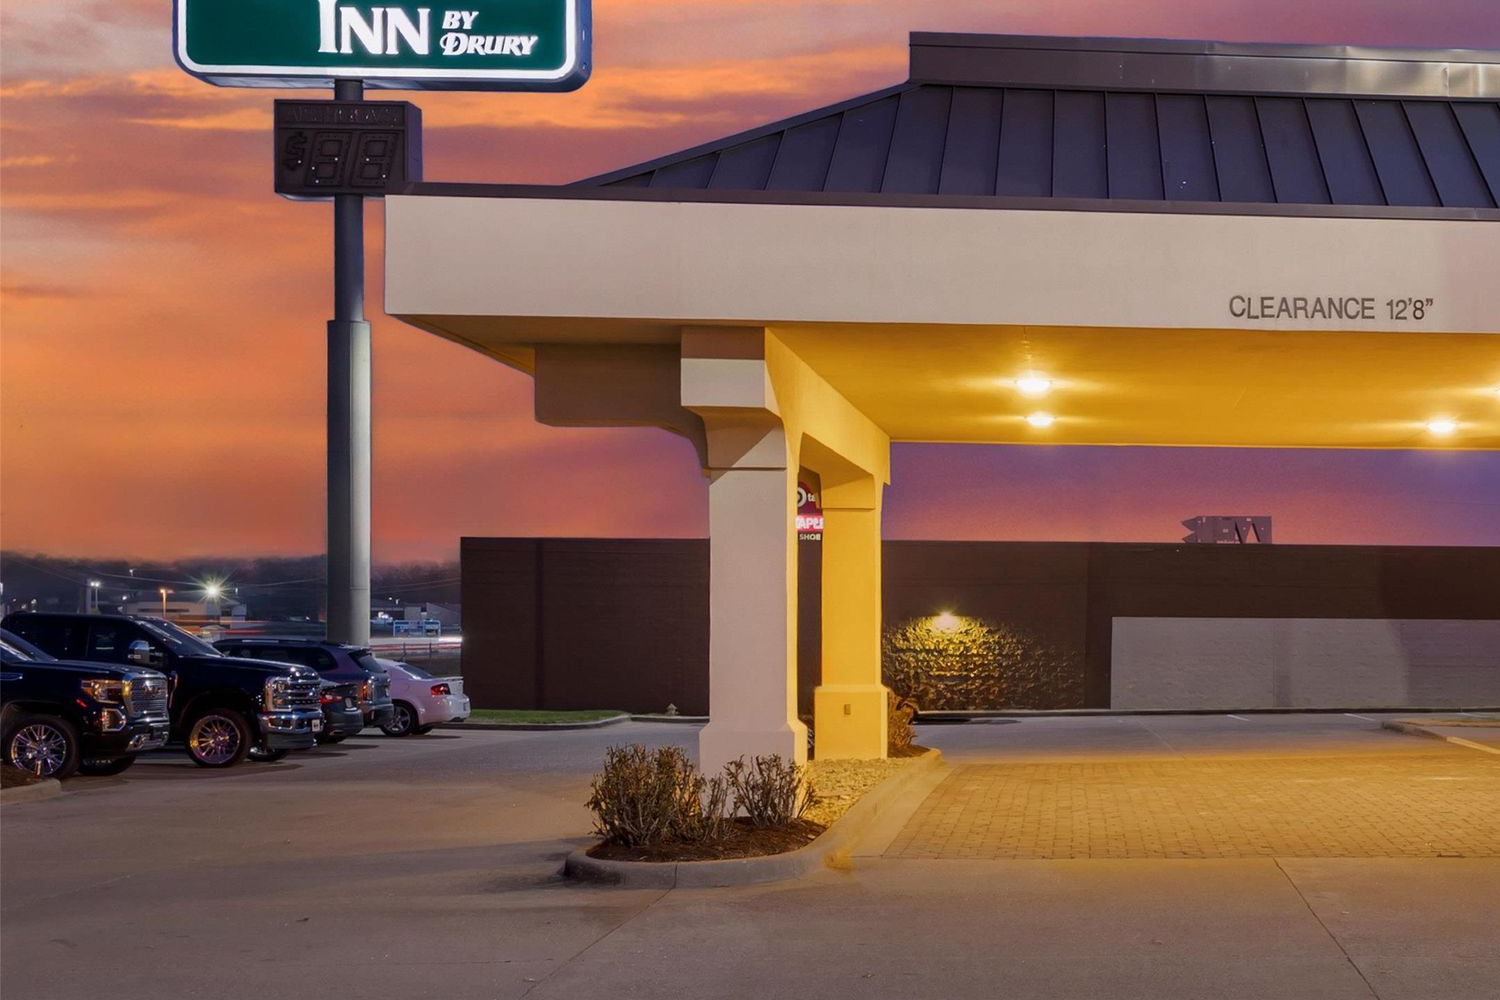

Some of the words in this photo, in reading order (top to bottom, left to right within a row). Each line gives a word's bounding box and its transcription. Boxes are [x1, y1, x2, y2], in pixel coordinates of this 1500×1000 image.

[442, 10, 480, 30] BY
[439, 32, 539, 57] DRURY
[1229, 295, 1376, 320] CLEARANCE
